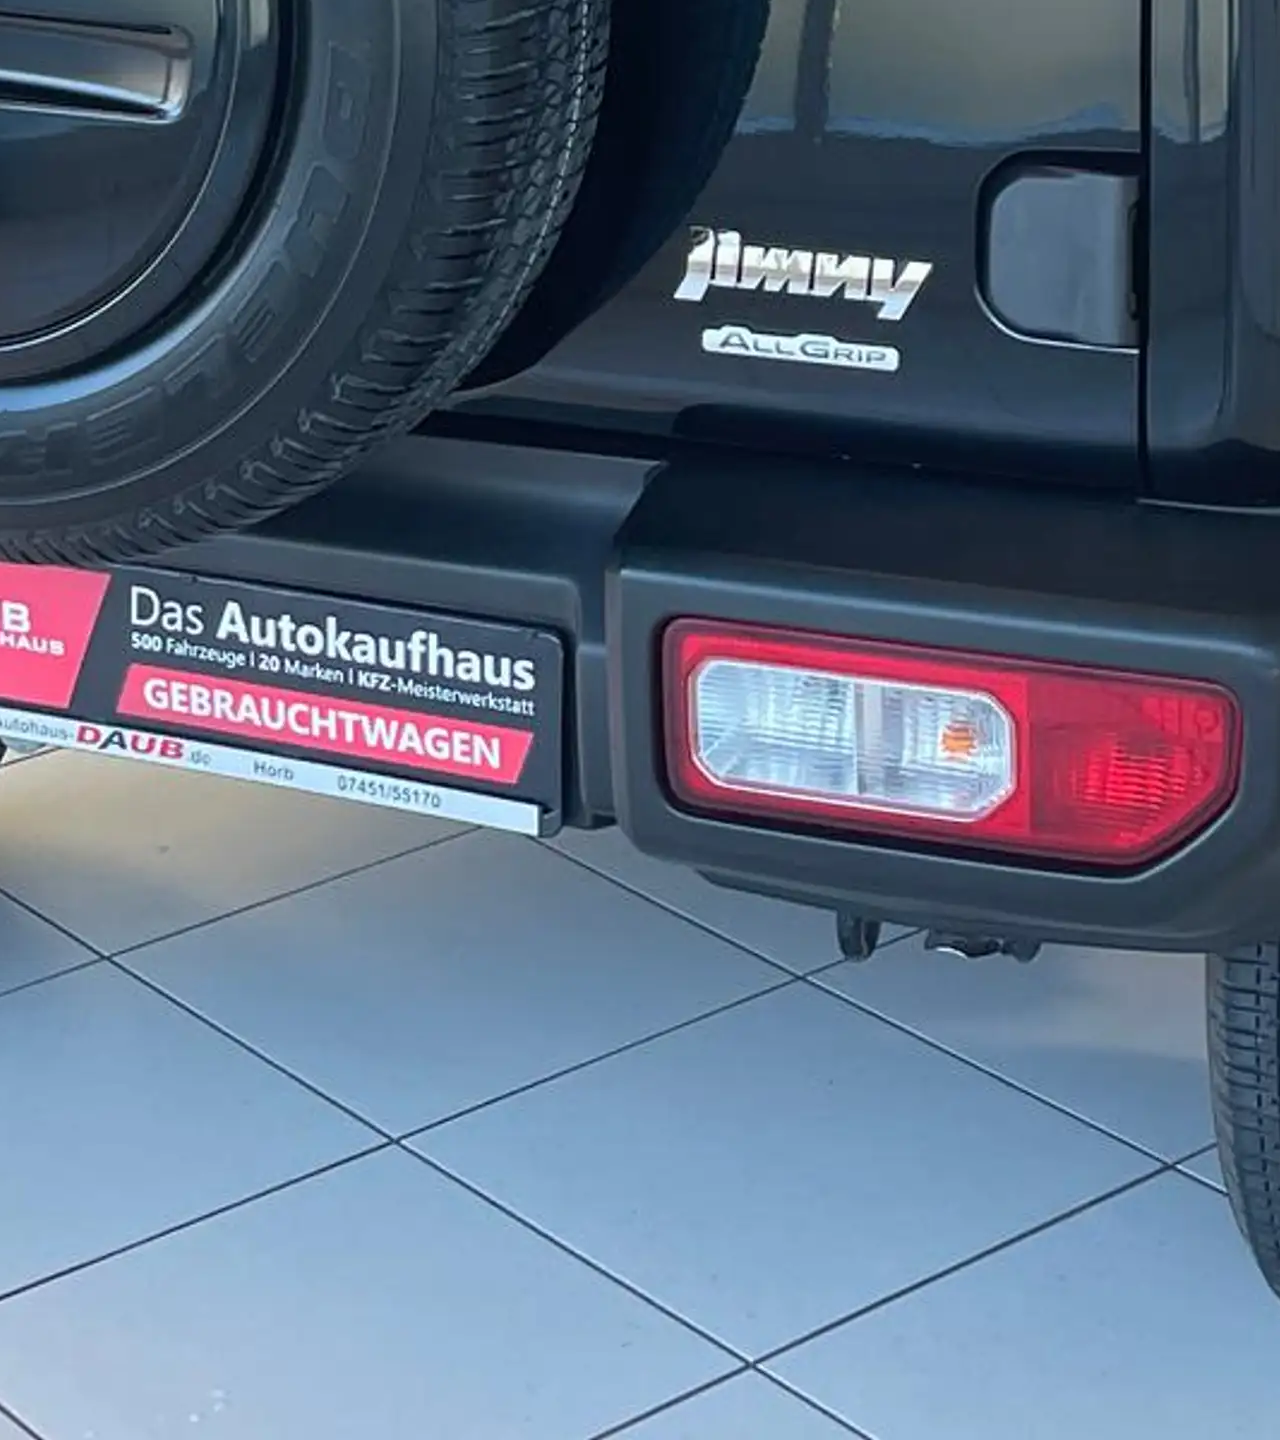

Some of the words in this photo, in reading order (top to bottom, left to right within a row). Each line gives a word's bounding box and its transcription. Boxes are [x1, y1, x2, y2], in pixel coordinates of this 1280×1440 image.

[130, 584, 205, 635] Das
[215, 599, 536, 691] Autokaufhaus
[131, 631, 163, 653] 500
[166, 637, 246, 669] Fahrzeuge
[258, 653, 280, 673] 20
[284, 657, 345, 684] Marken
[357, 669, 535, 716] KFZ-Meisterwerkstatt
[143, 677, 501, 769] GEBRAUCHTWAGEN
[253, 760, 296, 782] Horb
